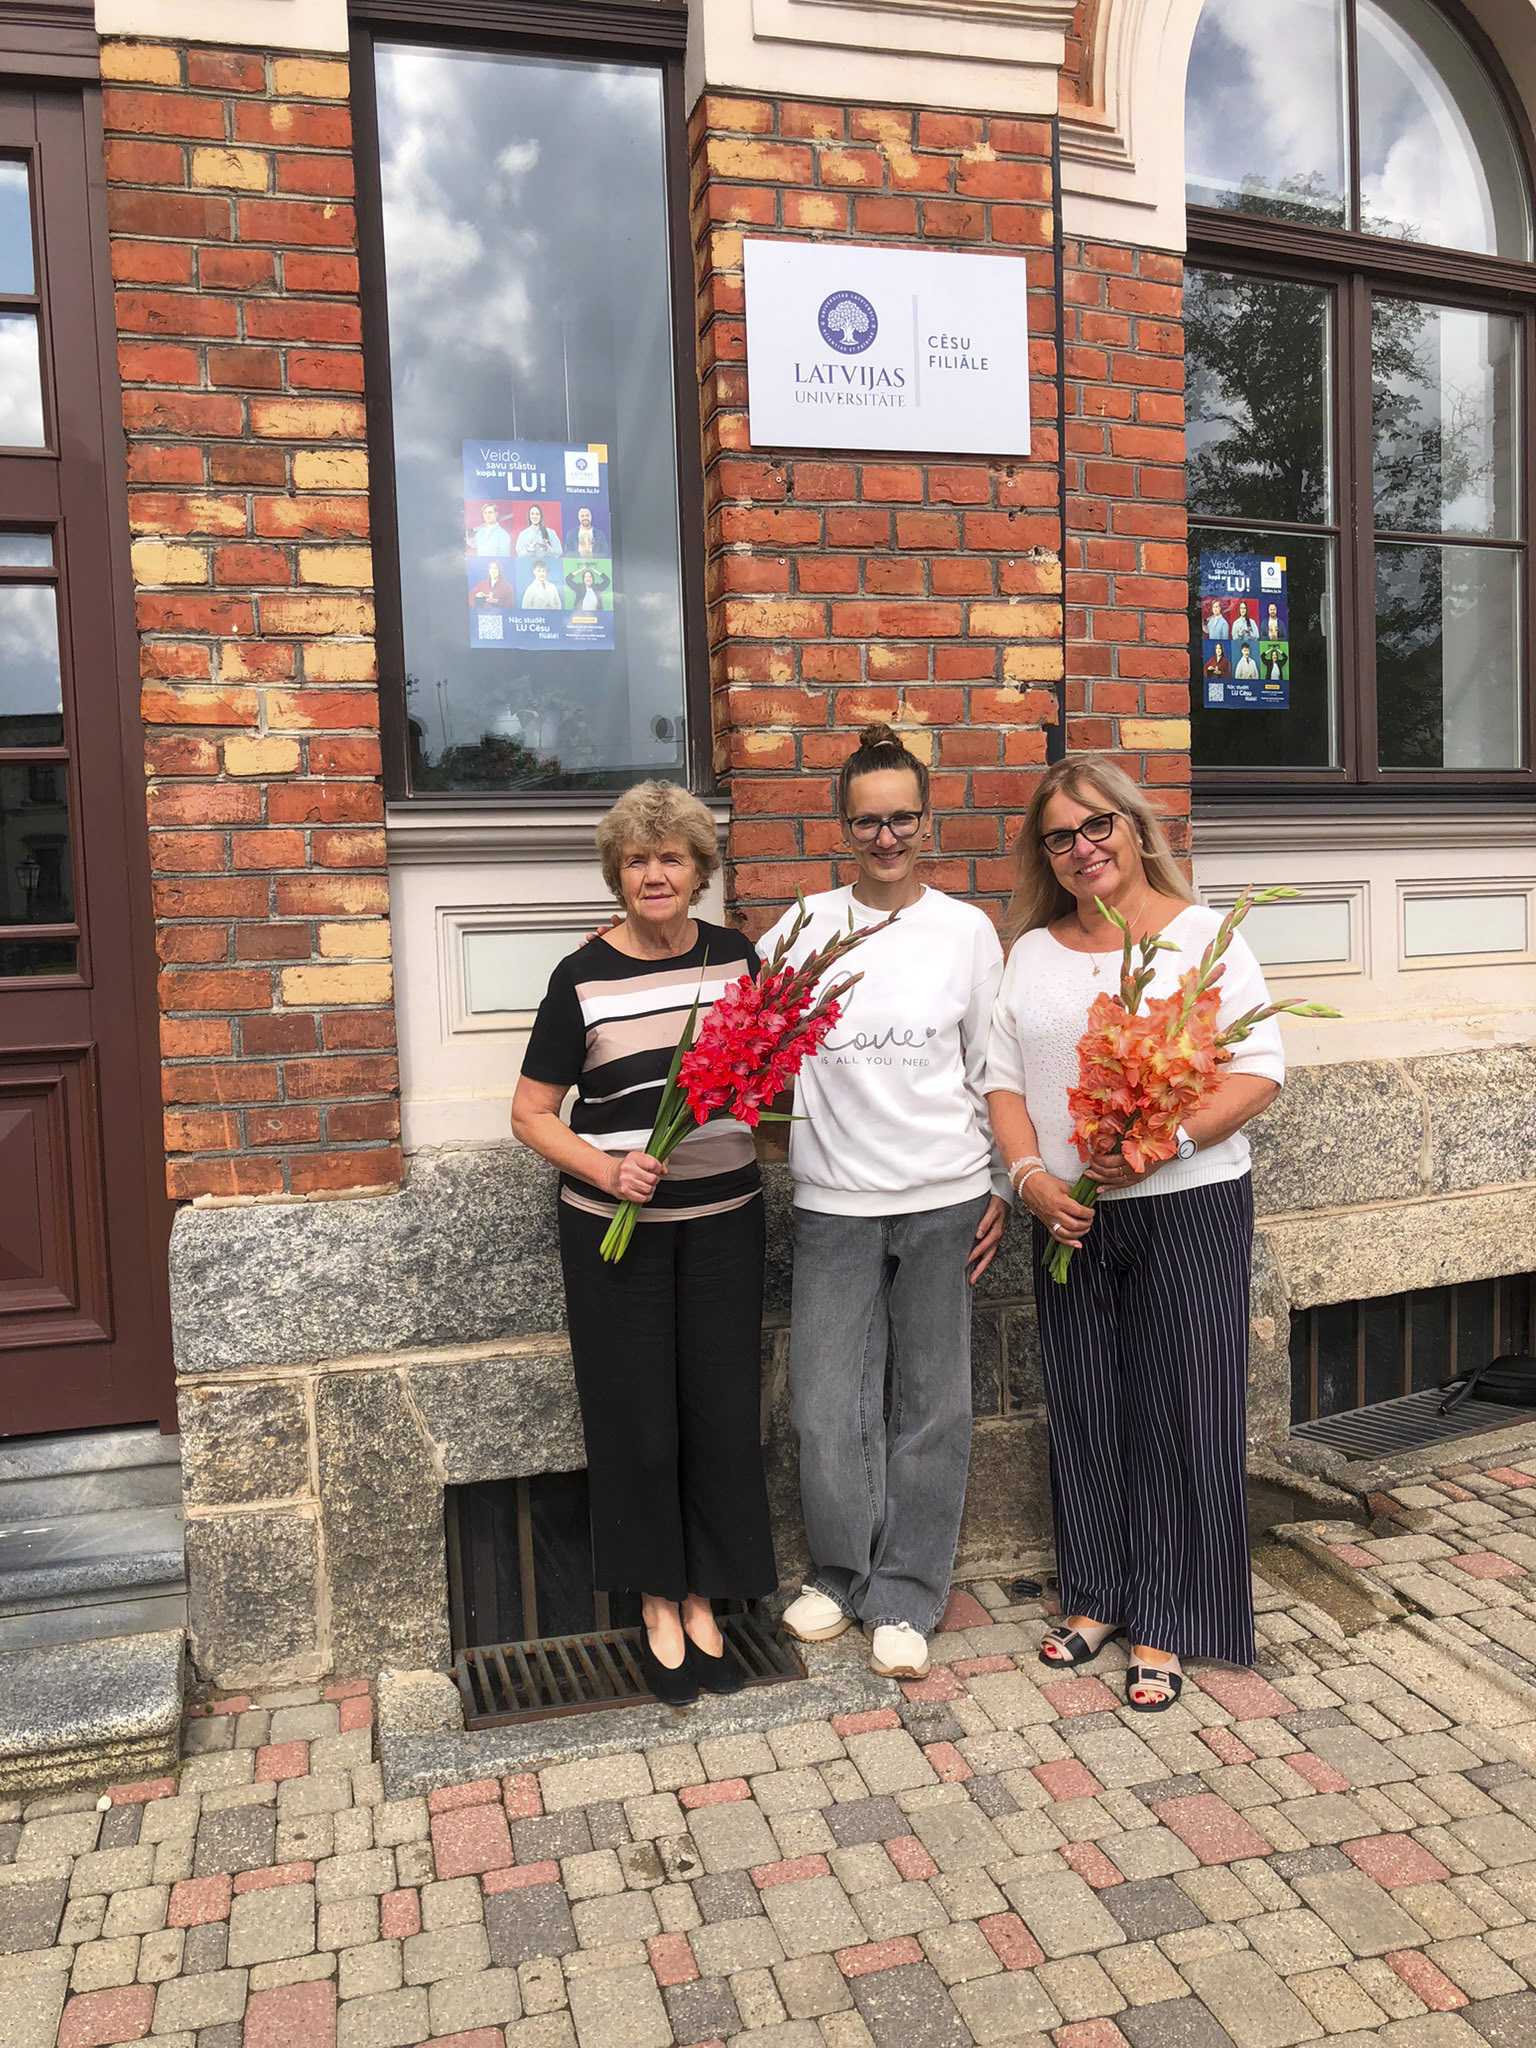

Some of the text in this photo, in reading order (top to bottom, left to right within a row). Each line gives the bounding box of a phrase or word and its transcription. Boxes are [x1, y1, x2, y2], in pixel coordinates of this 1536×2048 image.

[928, 333, 971, 351] CĒSU
[929, 354, 989, 371] FILIĀLE
[794, 362, 906, 391] LATVIJAS
[795, 390, 906, 408] UNIVERSITĀTE
[480, 448, 521, 462] Veido
[486, 462, 537, 471] savu stāstu
[476, 469, 496, 479] kopā
[507, 472, 547, 493] LU!
[1210, 558, 1236, 570] Veido
[1227, 575, 1251, 593] LU!
[516, 624, 551, 633] LU Cēsu
[821, 1056, 930, 1067] IS ALL YOU NEED
